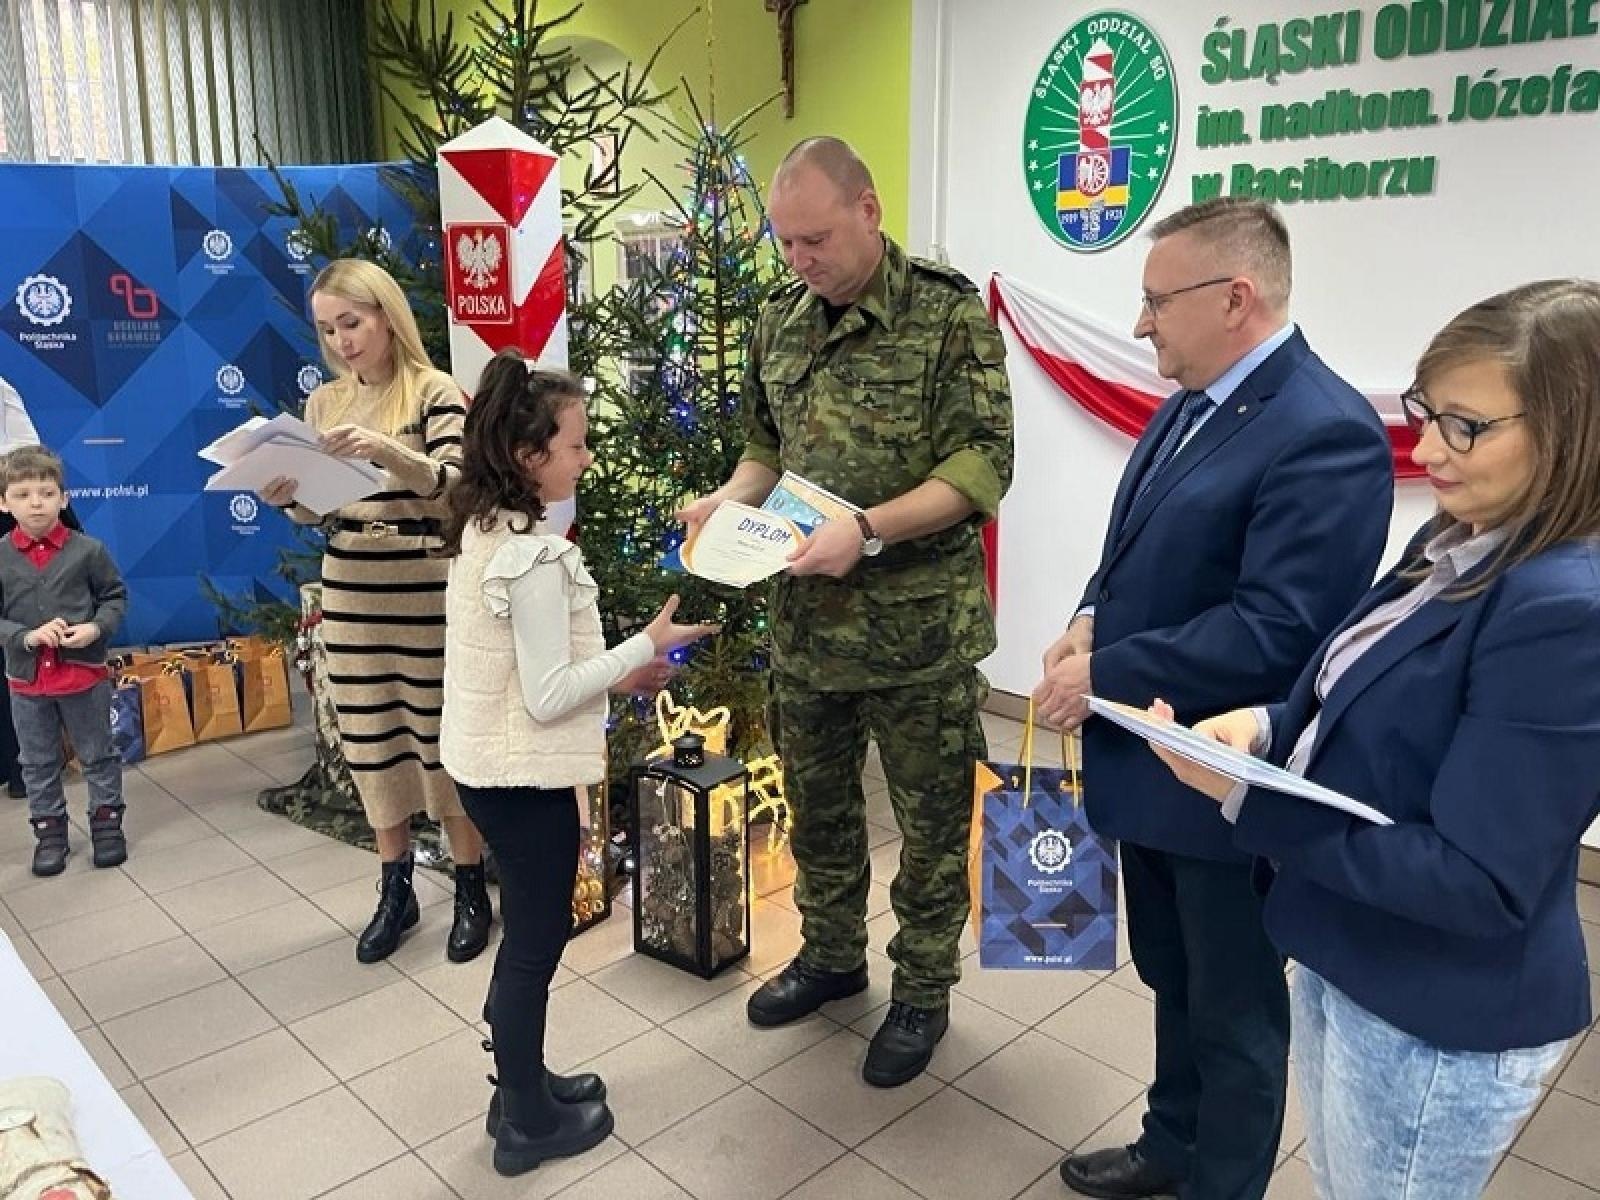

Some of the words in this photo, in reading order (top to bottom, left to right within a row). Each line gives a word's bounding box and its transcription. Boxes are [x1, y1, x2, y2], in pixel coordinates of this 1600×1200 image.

[1201, 16, 1361, 86] ŚLĄSKI
[1374, 0, 1600, 60] ODDZIAŁ
[1195, 104, 1252, 149] im.
[1260, 88, 1440, 143] nadkom.
[1447, 63, 1600, 123] Józefa
[1191, 172, 1222, 205] w
[1229, 155, 1437, 204] Raciborzu
[457, 294, 507, 315] POLSKA
[19, 332, 77, 342] Politechnika
[737, 517, 793, 545] DYPLOM
